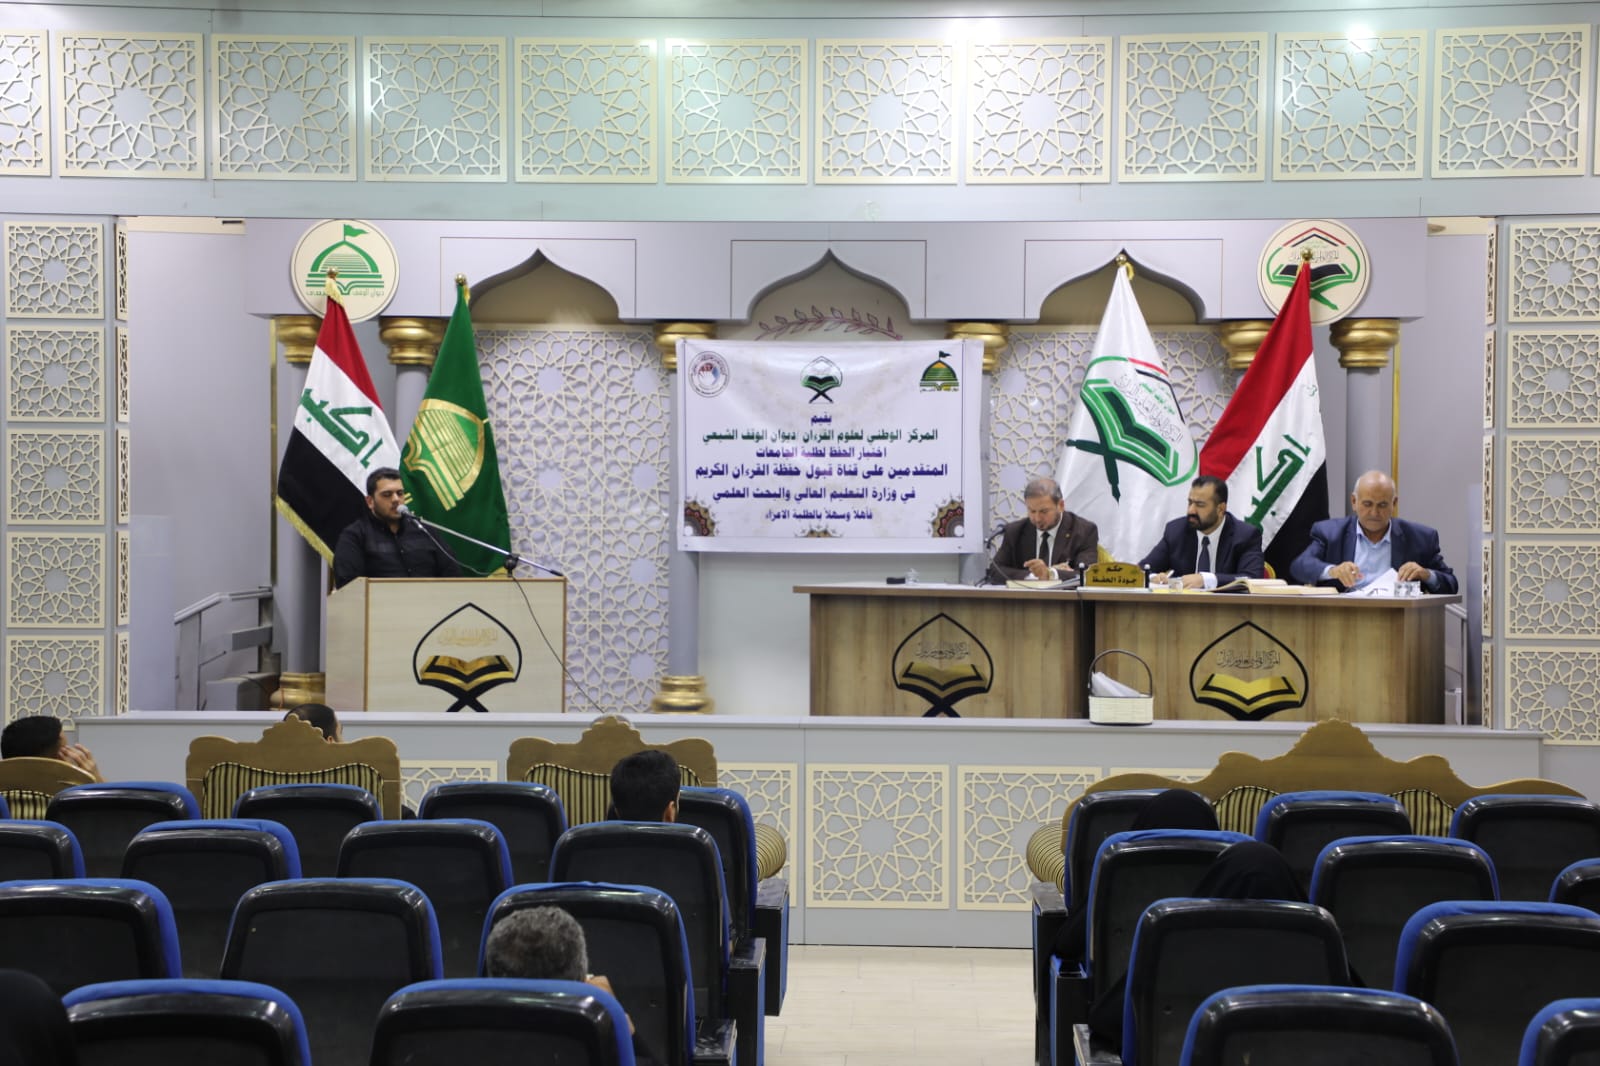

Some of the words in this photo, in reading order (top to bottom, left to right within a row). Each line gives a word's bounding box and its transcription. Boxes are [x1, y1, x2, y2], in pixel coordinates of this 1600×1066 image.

[702, 428, 738, 445] الشيعي
[741, 428, 767, 443] الوقف
[770, 428, 796, 443] ديوان
[837, 428, 863, 444] لعلوم
[866, 428, 902, 445] الوطني
[907, 428, 938, 443] المركز
[755, 446, 798, 460] الجامعات
[801, 446, 826, 460] لطلبة
[829, 446, 855, 458] الحفظ
[695, 462, 729, 479] الكريم
[773, 462, 801, 476] حفظة
[805, 462, 833, 479] قبول
[837, 462, 858, 476] قناة
[862, 463, 884, 479] على
[888, 463, 948, 479] المتقدمين
[712, 487, 749, 504] العلمي
[752, 487, 791, 502] والبحث
[794, 487, 826, 504] العالي
[830, 487, 868, 502] التعليم
[872, 487, 897, 502] وزارة
[901, 487, 916, 504] في
[1092, 576, 1117, 584] الحفظ
